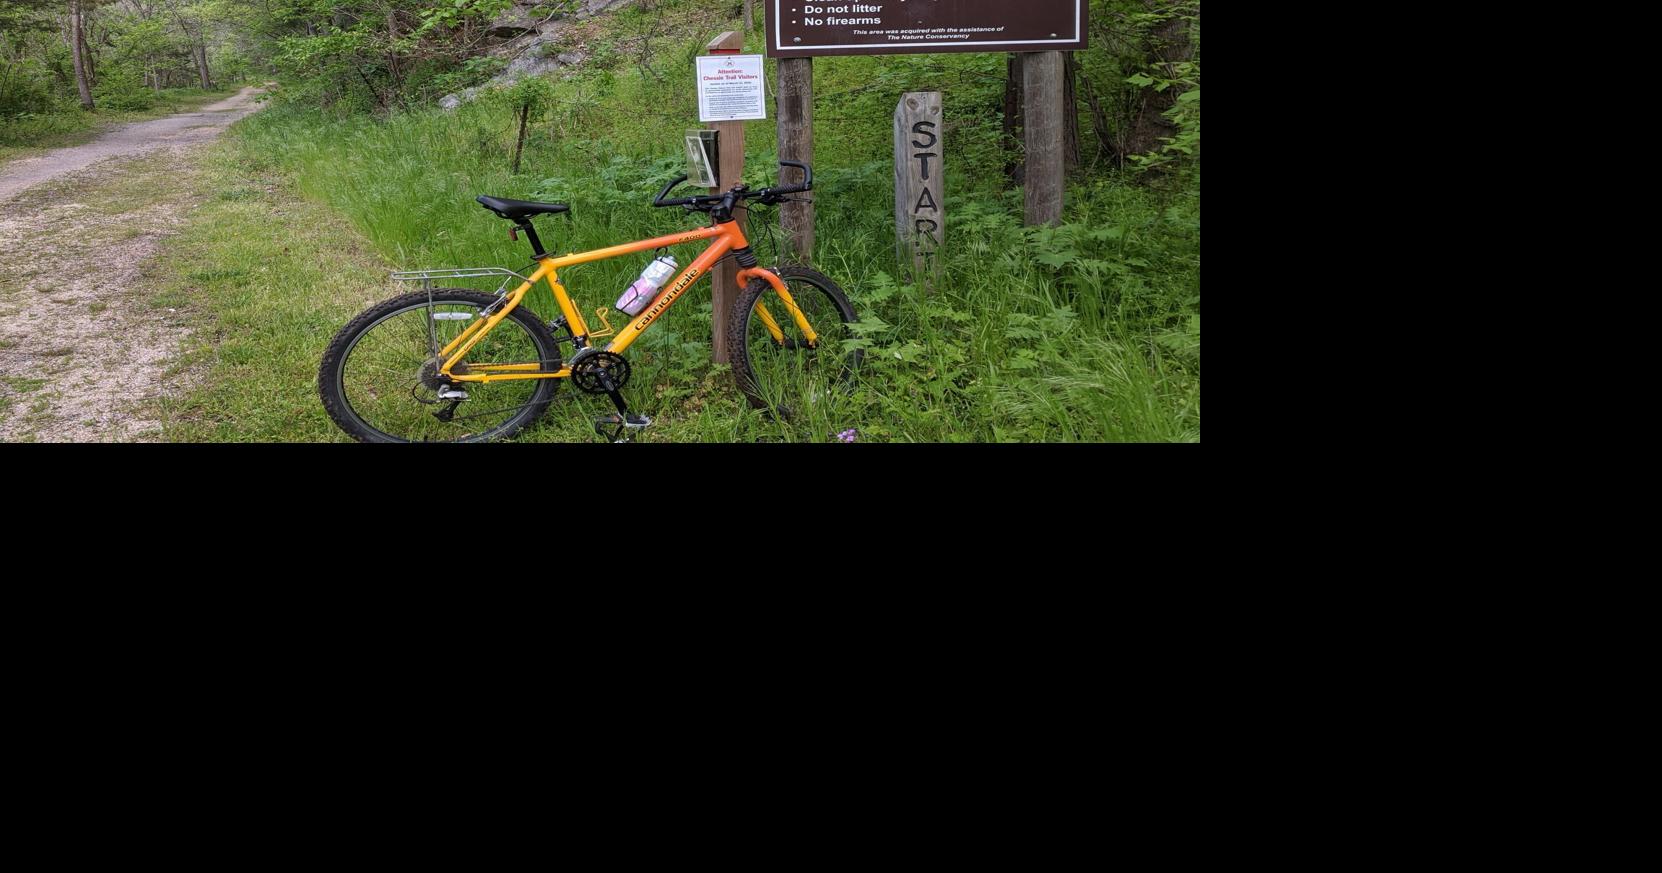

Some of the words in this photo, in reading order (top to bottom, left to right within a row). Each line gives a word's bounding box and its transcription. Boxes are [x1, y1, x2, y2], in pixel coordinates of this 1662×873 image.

[804, 5, 823, 14] Do
[827, 5, 849, 14] not
[852, 4, 883, 13] litter
[804, 17, 823, 26] No
[827, 16, 881, 26] firearms
[635, 269, 699, 331] cannondale
